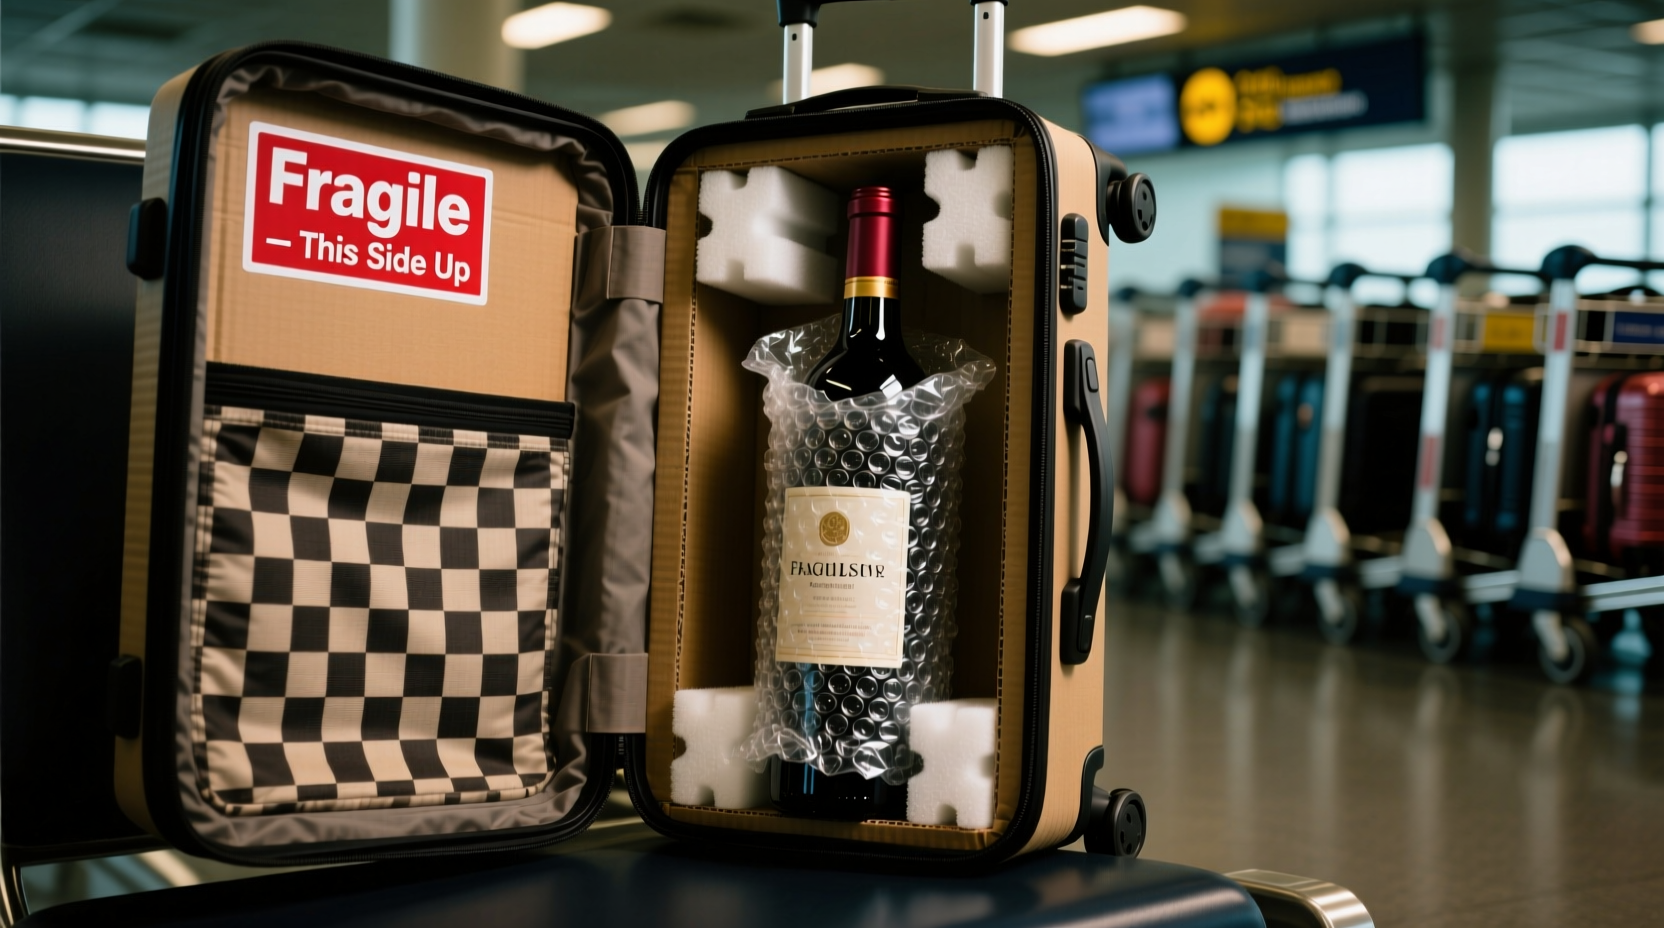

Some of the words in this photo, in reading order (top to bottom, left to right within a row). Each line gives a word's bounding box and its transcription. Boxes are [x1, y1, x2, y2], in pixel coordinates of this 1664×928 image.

[269, 147, 470, 238] Fragile
[299, 230, 359, 266] This
[366, 241, 427, 276] Side
[434, 251, 471, 287] Up
